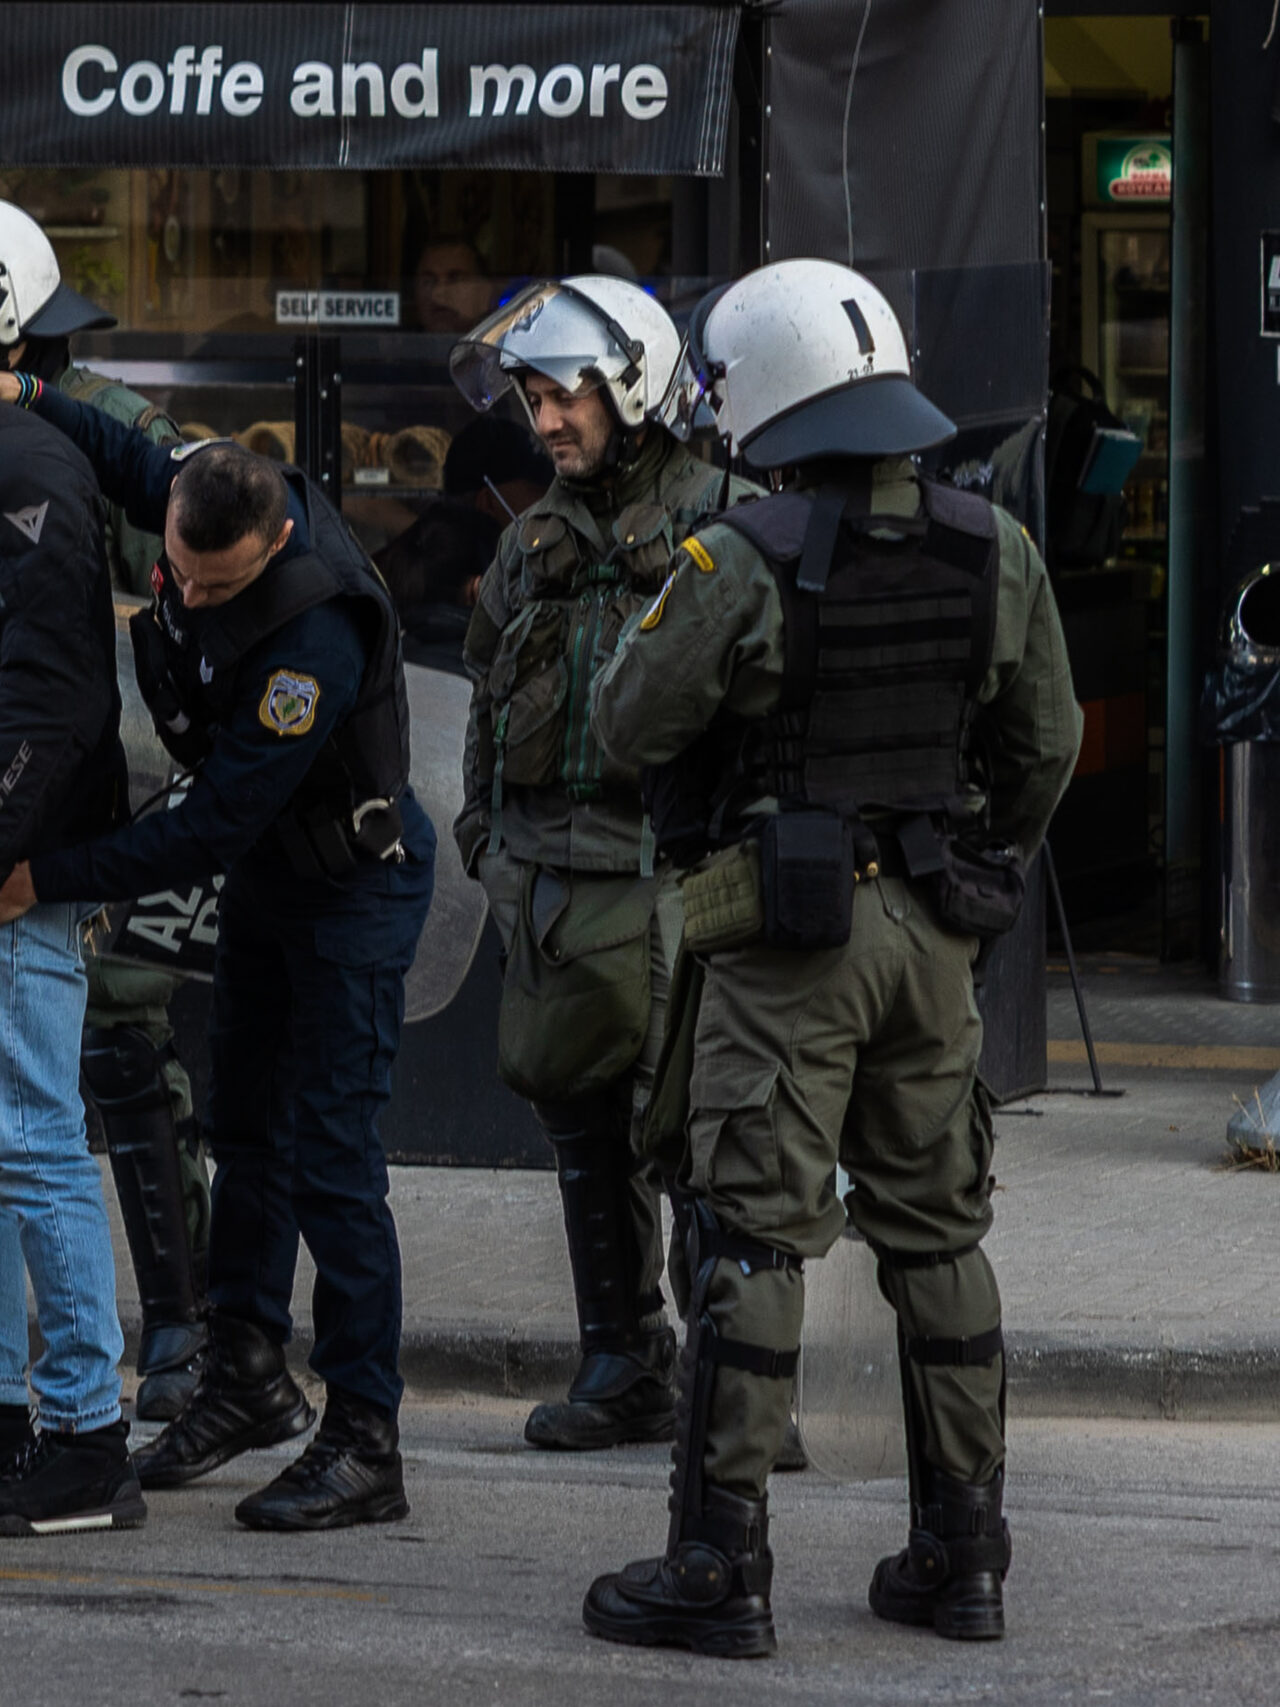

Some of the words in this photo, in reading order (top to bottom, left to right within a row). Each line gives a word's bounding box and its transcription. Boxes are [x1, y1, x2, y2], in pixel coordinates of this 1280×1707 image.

[62, 44, 264, 117] Coffe
[290, 47, 439, 118] and
[468, 63, 669, 121] more
[280, 298, 318, 317] SELF
[324, 298, 394, 317] SERVICE
